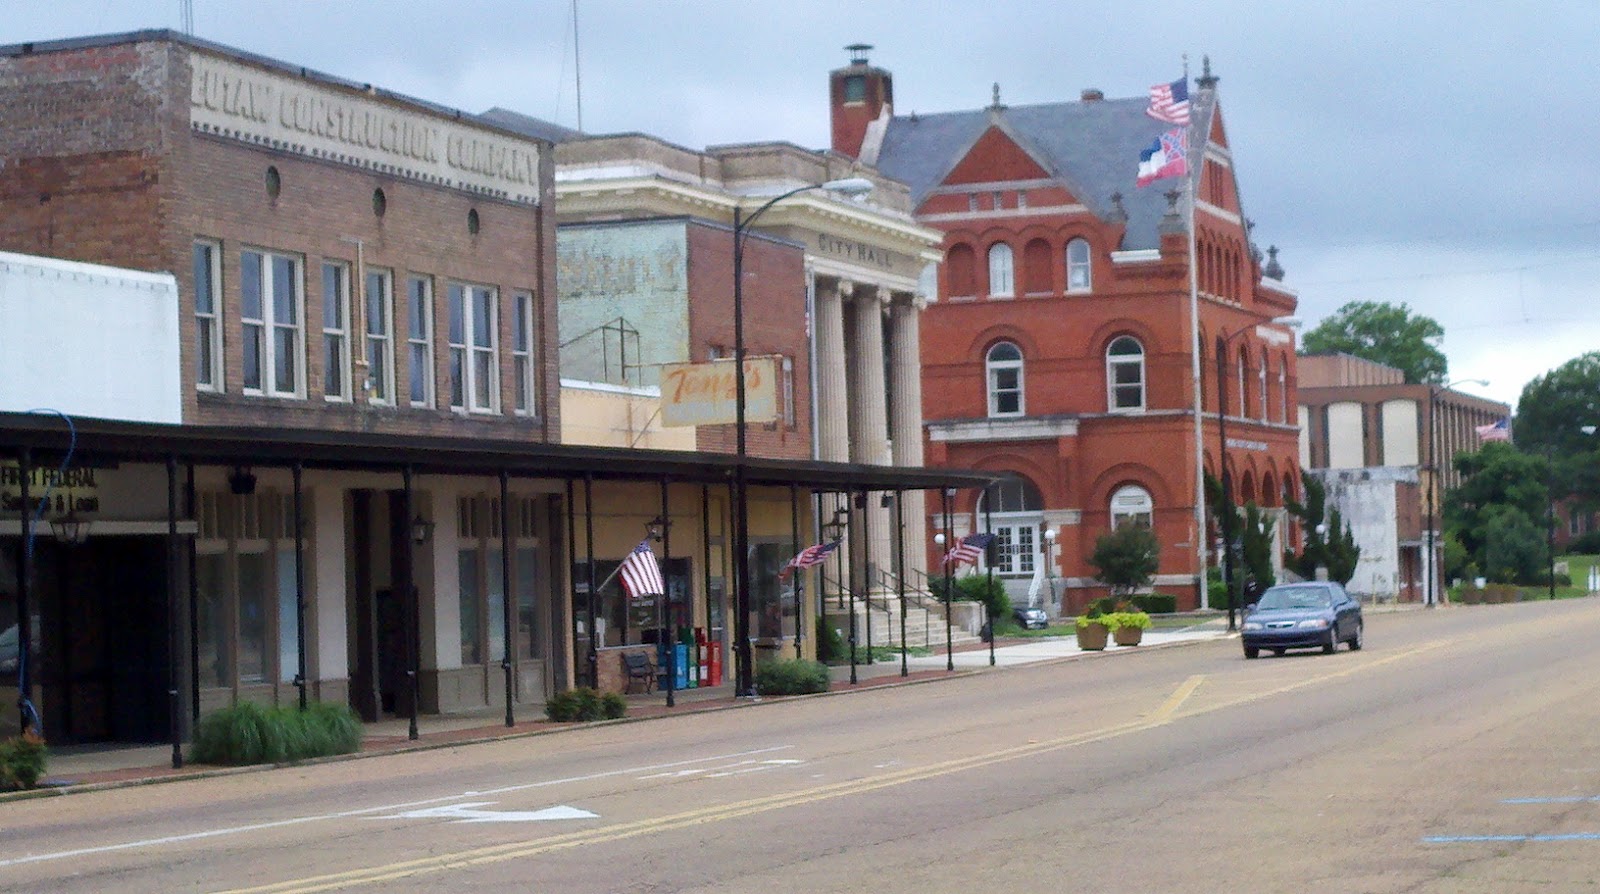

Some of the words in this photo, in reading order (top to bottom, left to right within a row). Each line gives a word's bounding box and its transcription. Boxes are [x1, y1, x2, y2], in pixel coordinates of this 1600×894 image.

[279, 89, 440, 163] CONSTRUCTION
[446, 134, 540, 186] COMPANY
[818, 232, 853, 256] CITY
[857, 242, 893, 268] HALL
[1, 466, 38, 486] FIRT
